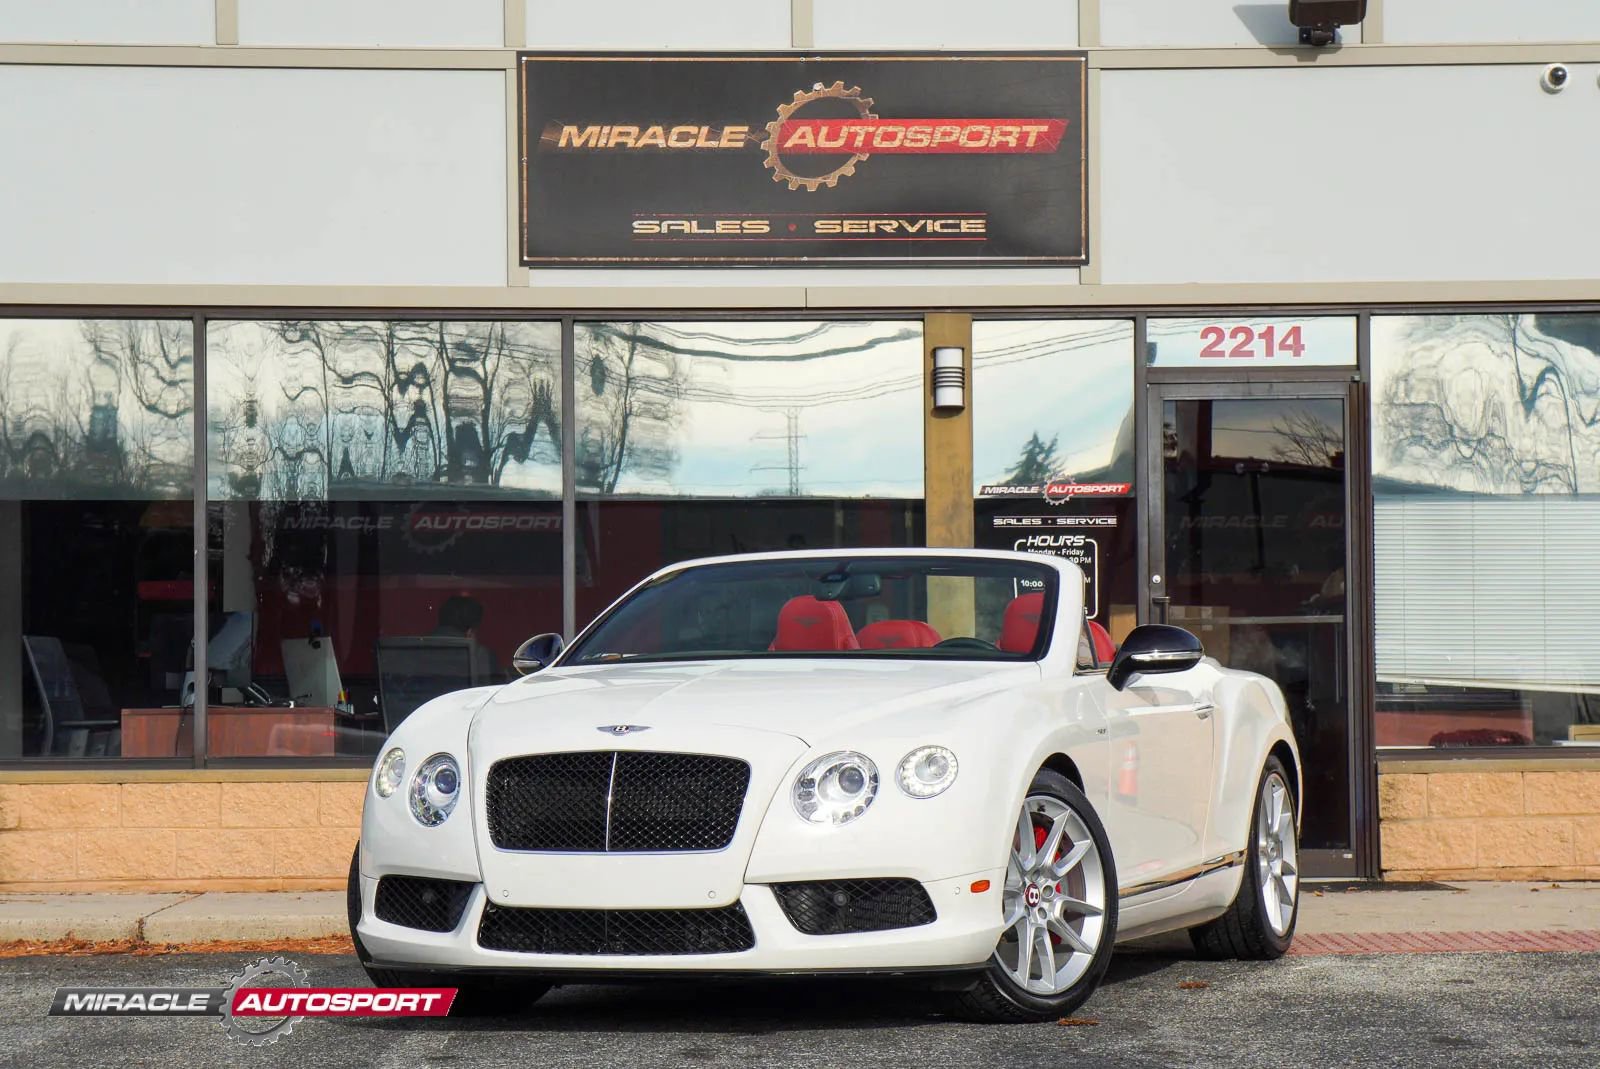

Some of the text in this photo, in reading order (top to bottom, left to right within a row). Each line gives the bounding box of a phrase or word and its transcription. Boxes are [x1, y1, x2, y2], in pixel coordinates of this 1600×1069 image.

[557, 124, 1050, 149] MIRACLE AUTOSPORT
[632, 220, 987, 235] SALES SERVICE
[1199, 325, 1306, 358] 2214
[984, 485, 1125, 494] MIRACLE AUTOSPORT
[284, 514, 562, 530] MIRACLE AUTOSPORT
[1027, 535, 1086, 547] HOURS
[1062, 548, 1084, 556] Friday
[1020, 579, 1043, 587] 10:00
